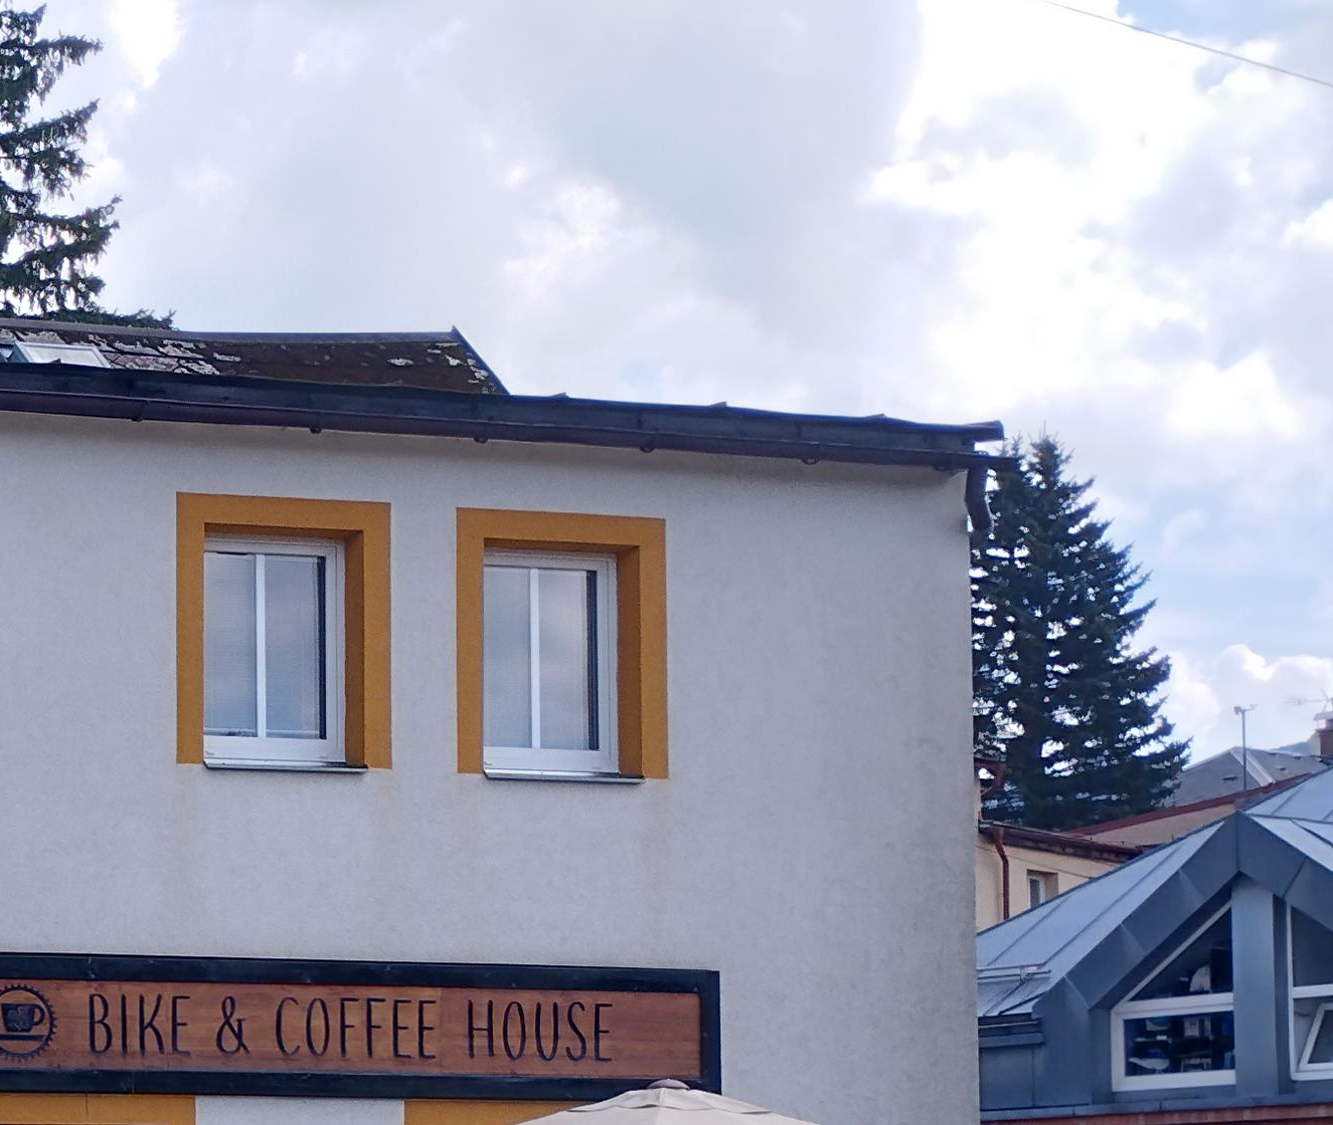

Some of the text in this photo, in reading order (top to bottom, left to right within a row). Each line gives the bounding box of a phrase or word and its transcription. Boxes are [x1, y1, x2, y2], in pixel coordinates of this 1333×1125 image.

[89, 994, 613, 1061] BIKE & COFFEE HOUSE
